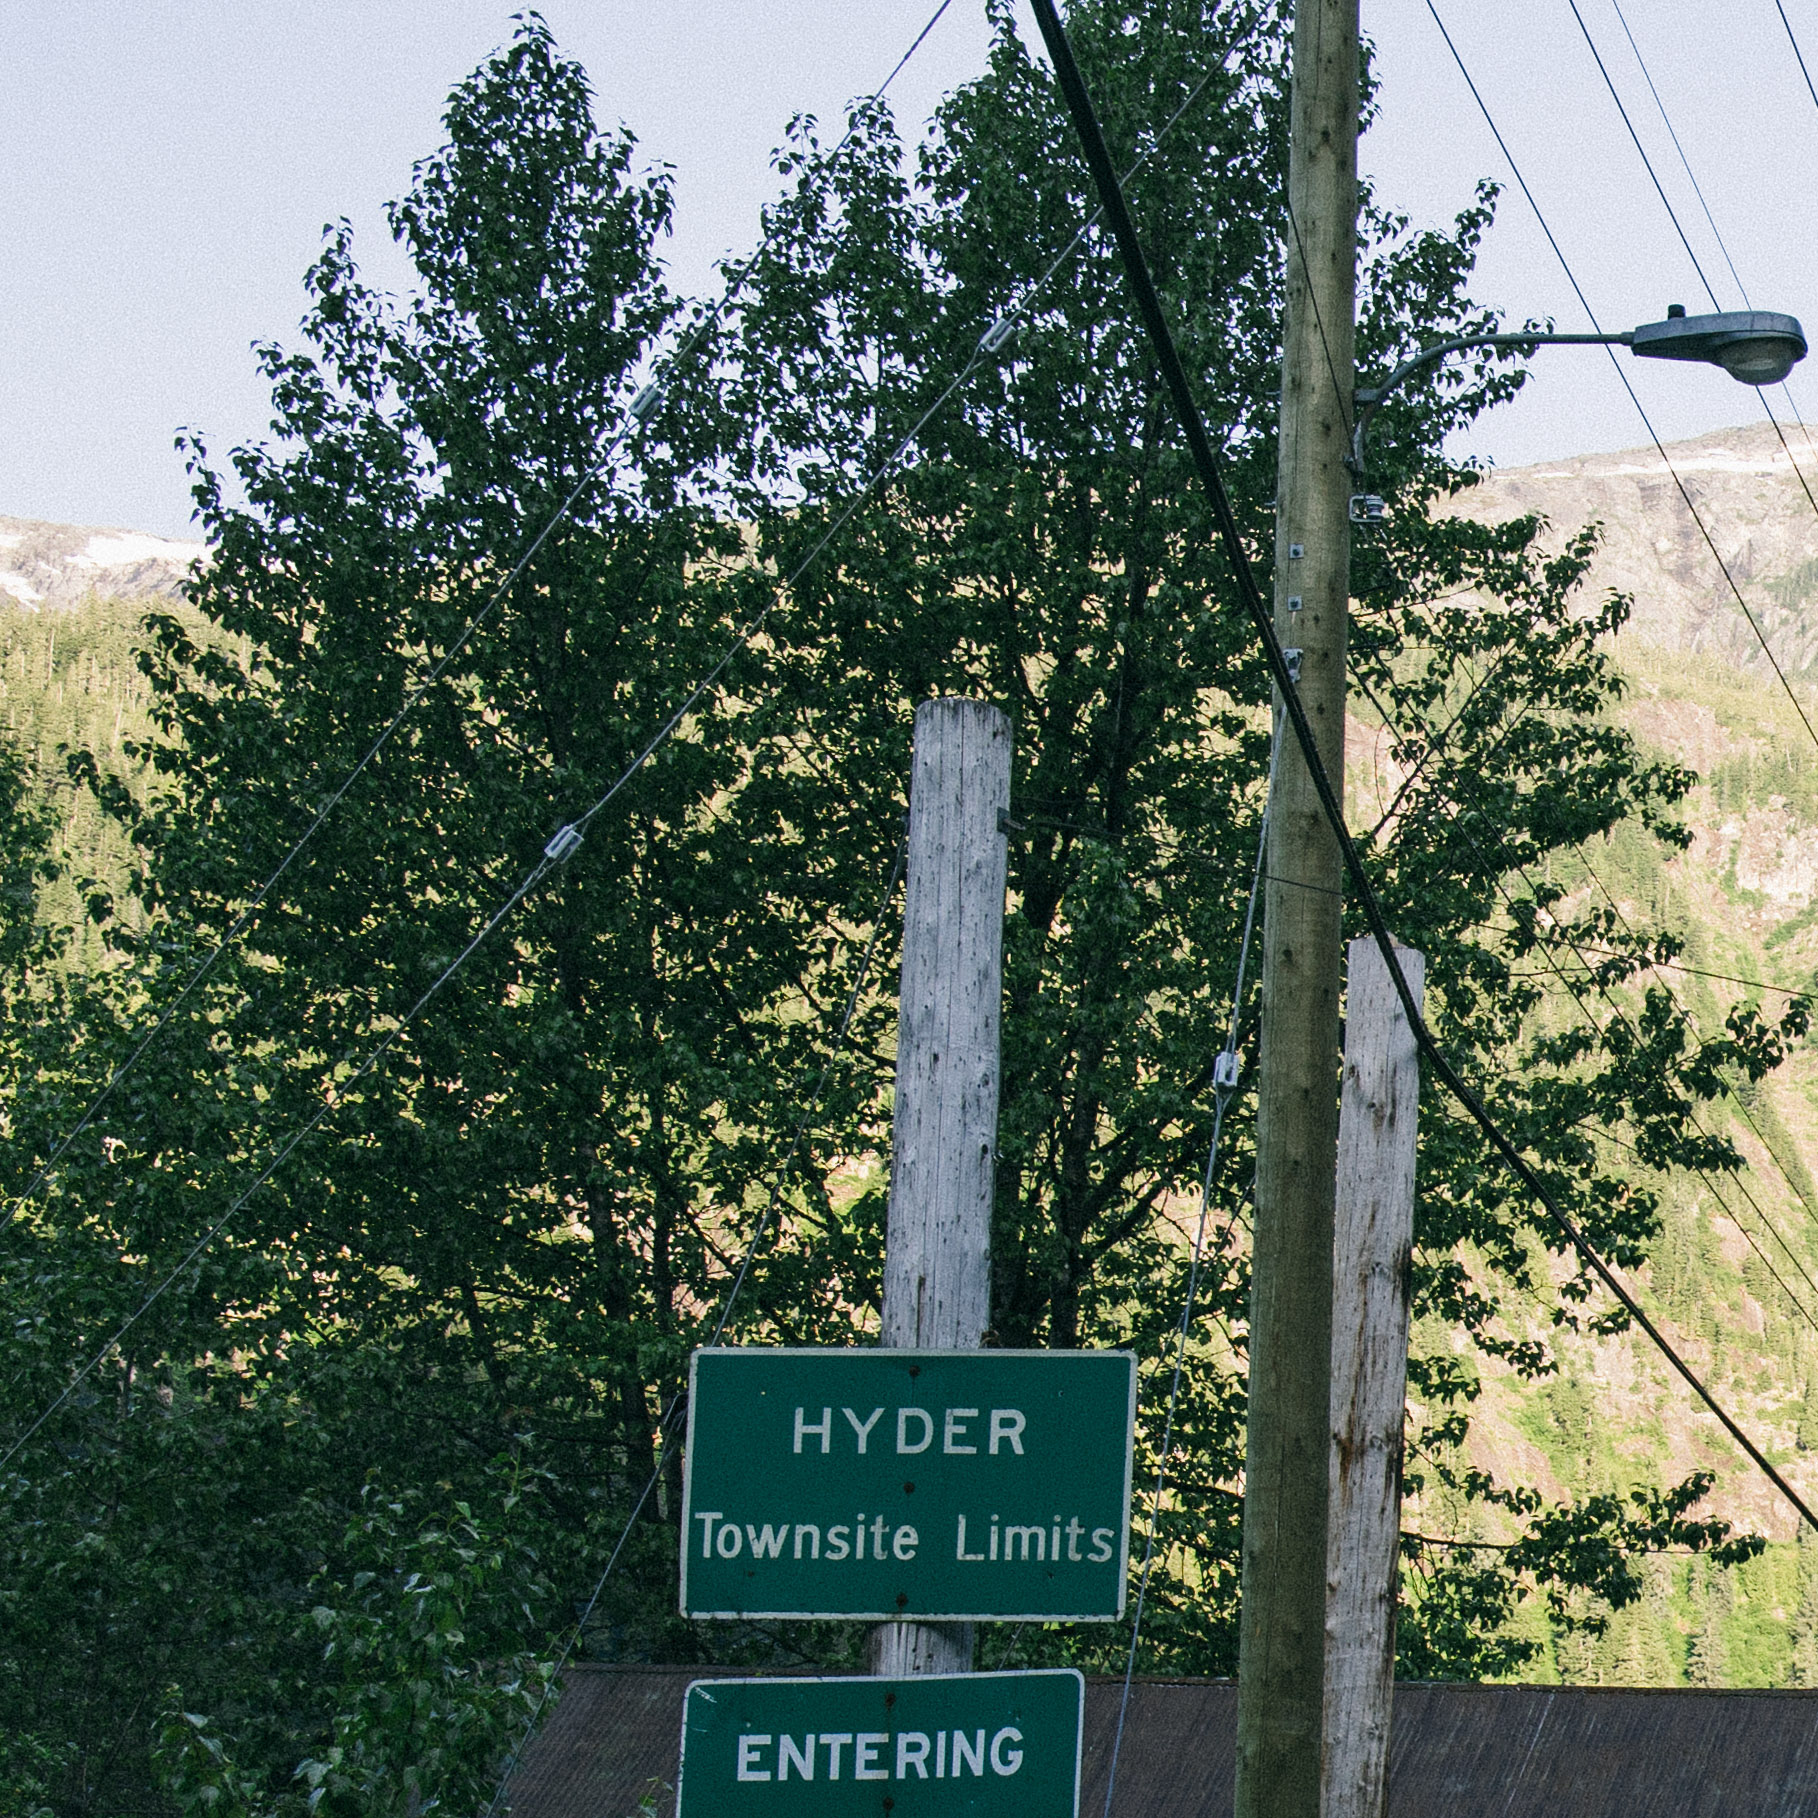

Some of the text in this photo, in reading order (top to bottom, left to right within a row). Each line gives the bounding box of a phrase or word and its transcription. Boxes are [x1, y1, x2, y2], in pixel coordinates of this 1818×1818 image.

[792, 1407, 1027, 1456] HYDER
[694, 1511, 1115, 1563] Townsite Limits
[736, 1726, 1025, 1783] ENTERING
